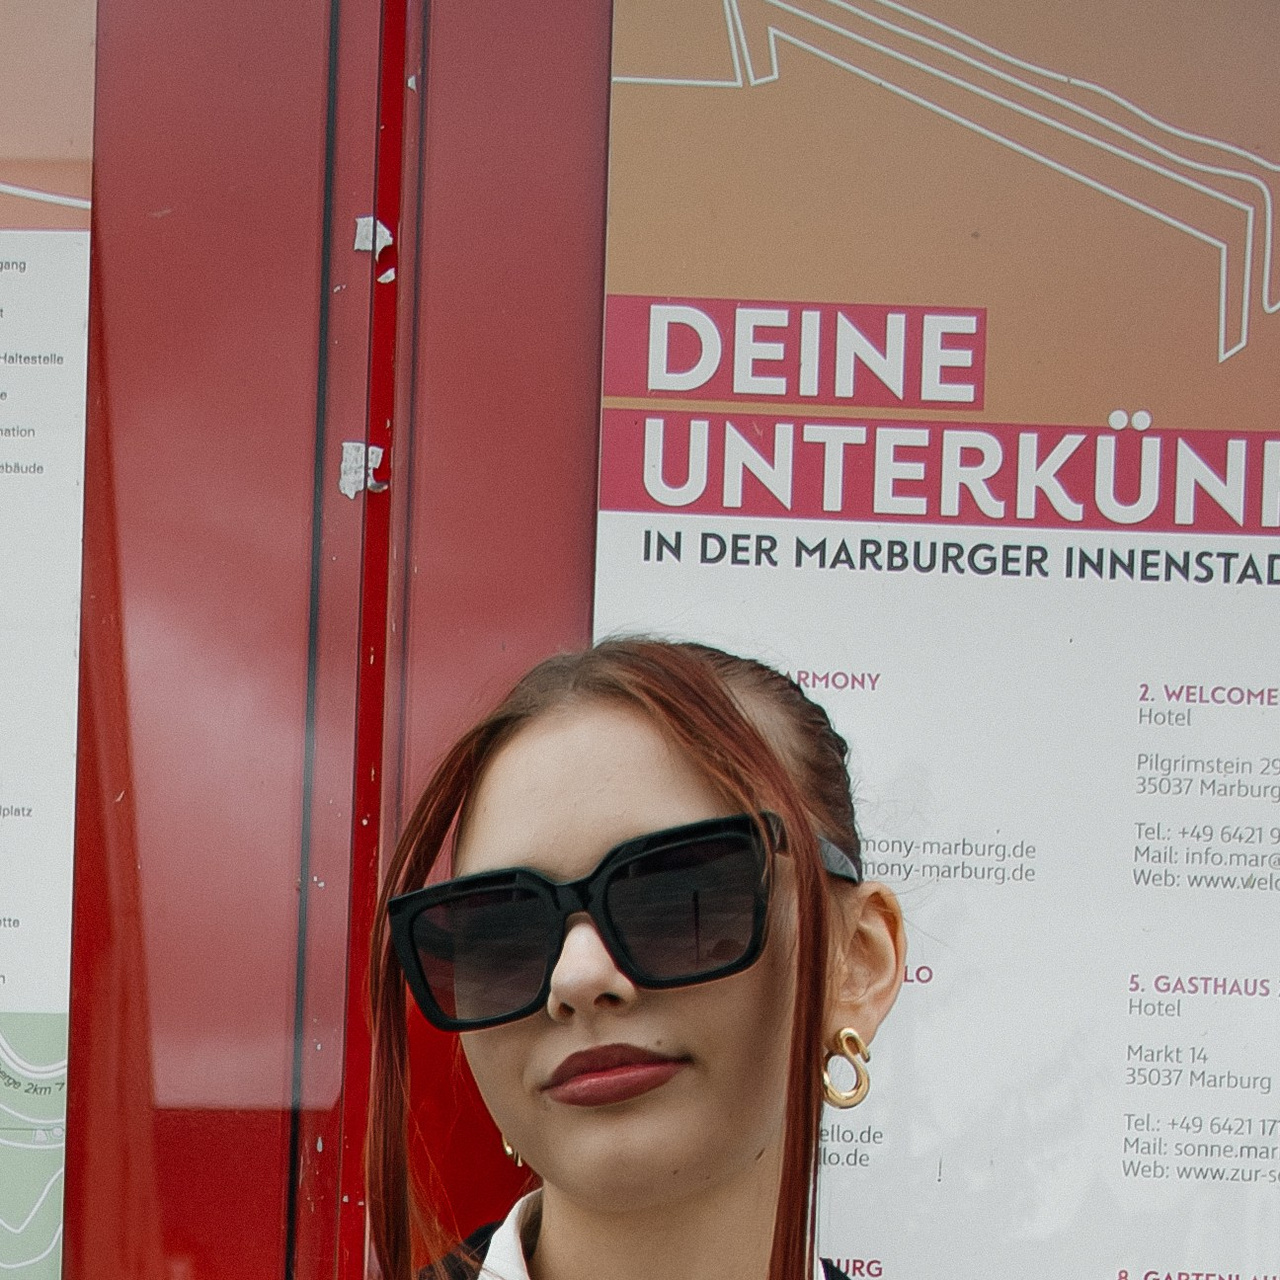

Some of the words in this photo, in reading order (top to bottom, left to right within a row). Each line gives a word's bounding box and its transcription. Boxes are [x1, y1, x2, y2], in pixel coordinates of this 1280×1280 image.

[647, 304, 977, 403] DEINE
[643, 529, 683, 564] IN
[699, 532, 778, 567] DER
[794, 537, 1049, 578] MARBURGER
[1139, 684, 1154, 702] 2.
[1163, 684, 1279, 706] WELCOME
[1138, 708, 1192, 726] Hotel
[1137, 753, 1252, 777] Pilgrimstein
[1136, 777, 1193, 795] 35037
[1199, 779, 1280, 803] Marburg
[1134, 822, 1171, 841] Tel.:
[1178, 824, 1213, 842] +49
[1220, 825, 1263, 844] 6421
[1134, 846, 1178, 864] Mail:
[1133, 869, 1181, 887] Web:
[1128, 974, 1145, 993] 5.
[1153, 975, 1270, 997] GASTHAUS
[1128, 998, 1181, 1017] Hotel
[1126, 1045, 1182, 1064] Markt
[1190, 1047, 1209, 1064] 14
[1125, 1067, 1183, 1086] 35037
[1189, 1070, 1271, 1095] Marburg
[1124, 1113, 1161, 1132] Tel.:
[1168, 1116, 1203, 1134] +49
[1209, 1116, 1252, 1136] 6421
[1123, 1137, 1168, 1156] Mail:
[1122, 1160, 1170, 1179] Web:
